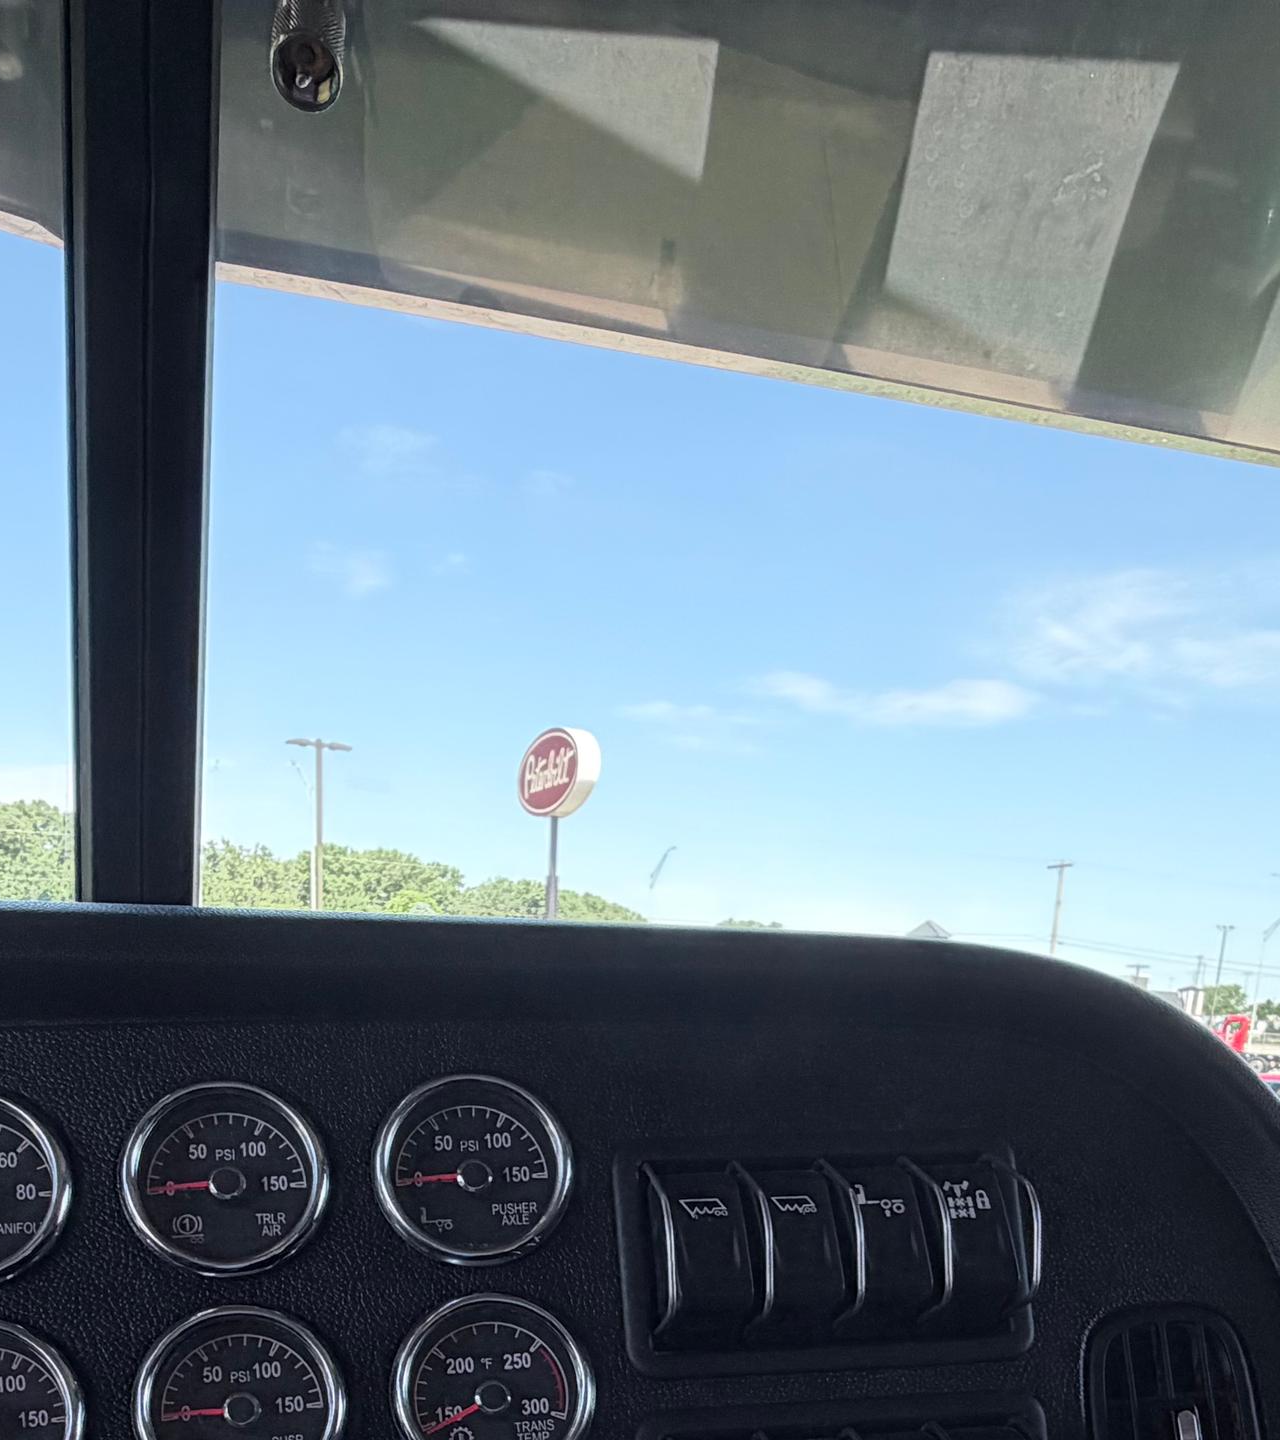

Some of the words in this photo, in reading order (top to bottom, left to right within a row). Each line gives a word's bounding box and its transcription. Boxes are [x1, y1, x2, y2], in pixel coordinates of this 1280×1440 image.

[434, 1135, 453, 1151] 50
[460, 1140, 479, 1152] PSI
[484, 1132, 512, 1149] 100
[188, 1143, 207, 1160] 50
[215, 1149, 235, 1161] PSI
[239, 1141, 267, 1158] 100
[502, 1166, 530, 1182] 150
[16, 1183, 37, 1200] 80
[261, 1175, 289, 1192] 150
[491, 1201, 538, 1216] PUSHER
[255, 1212, 287, 1225] TRLR
[501, 1212, 530, 1226] AXLE
[261, 1223, 282, 1236] AIR
[446, 1357, 475, 1374] 200
[502, 1352, 532, 1370] 250
[203, 1366, 222, 1383] 50
[229, 1371, 250, 1383] PSI
[252, 1362, 281, 1380] 100
[275, 1396, 304, 1413] 150
[521, 1398, 550, 1415] 300
[17, 1410, 49, 1428] 150
[514, 1419, 555, 1433] TRANS
